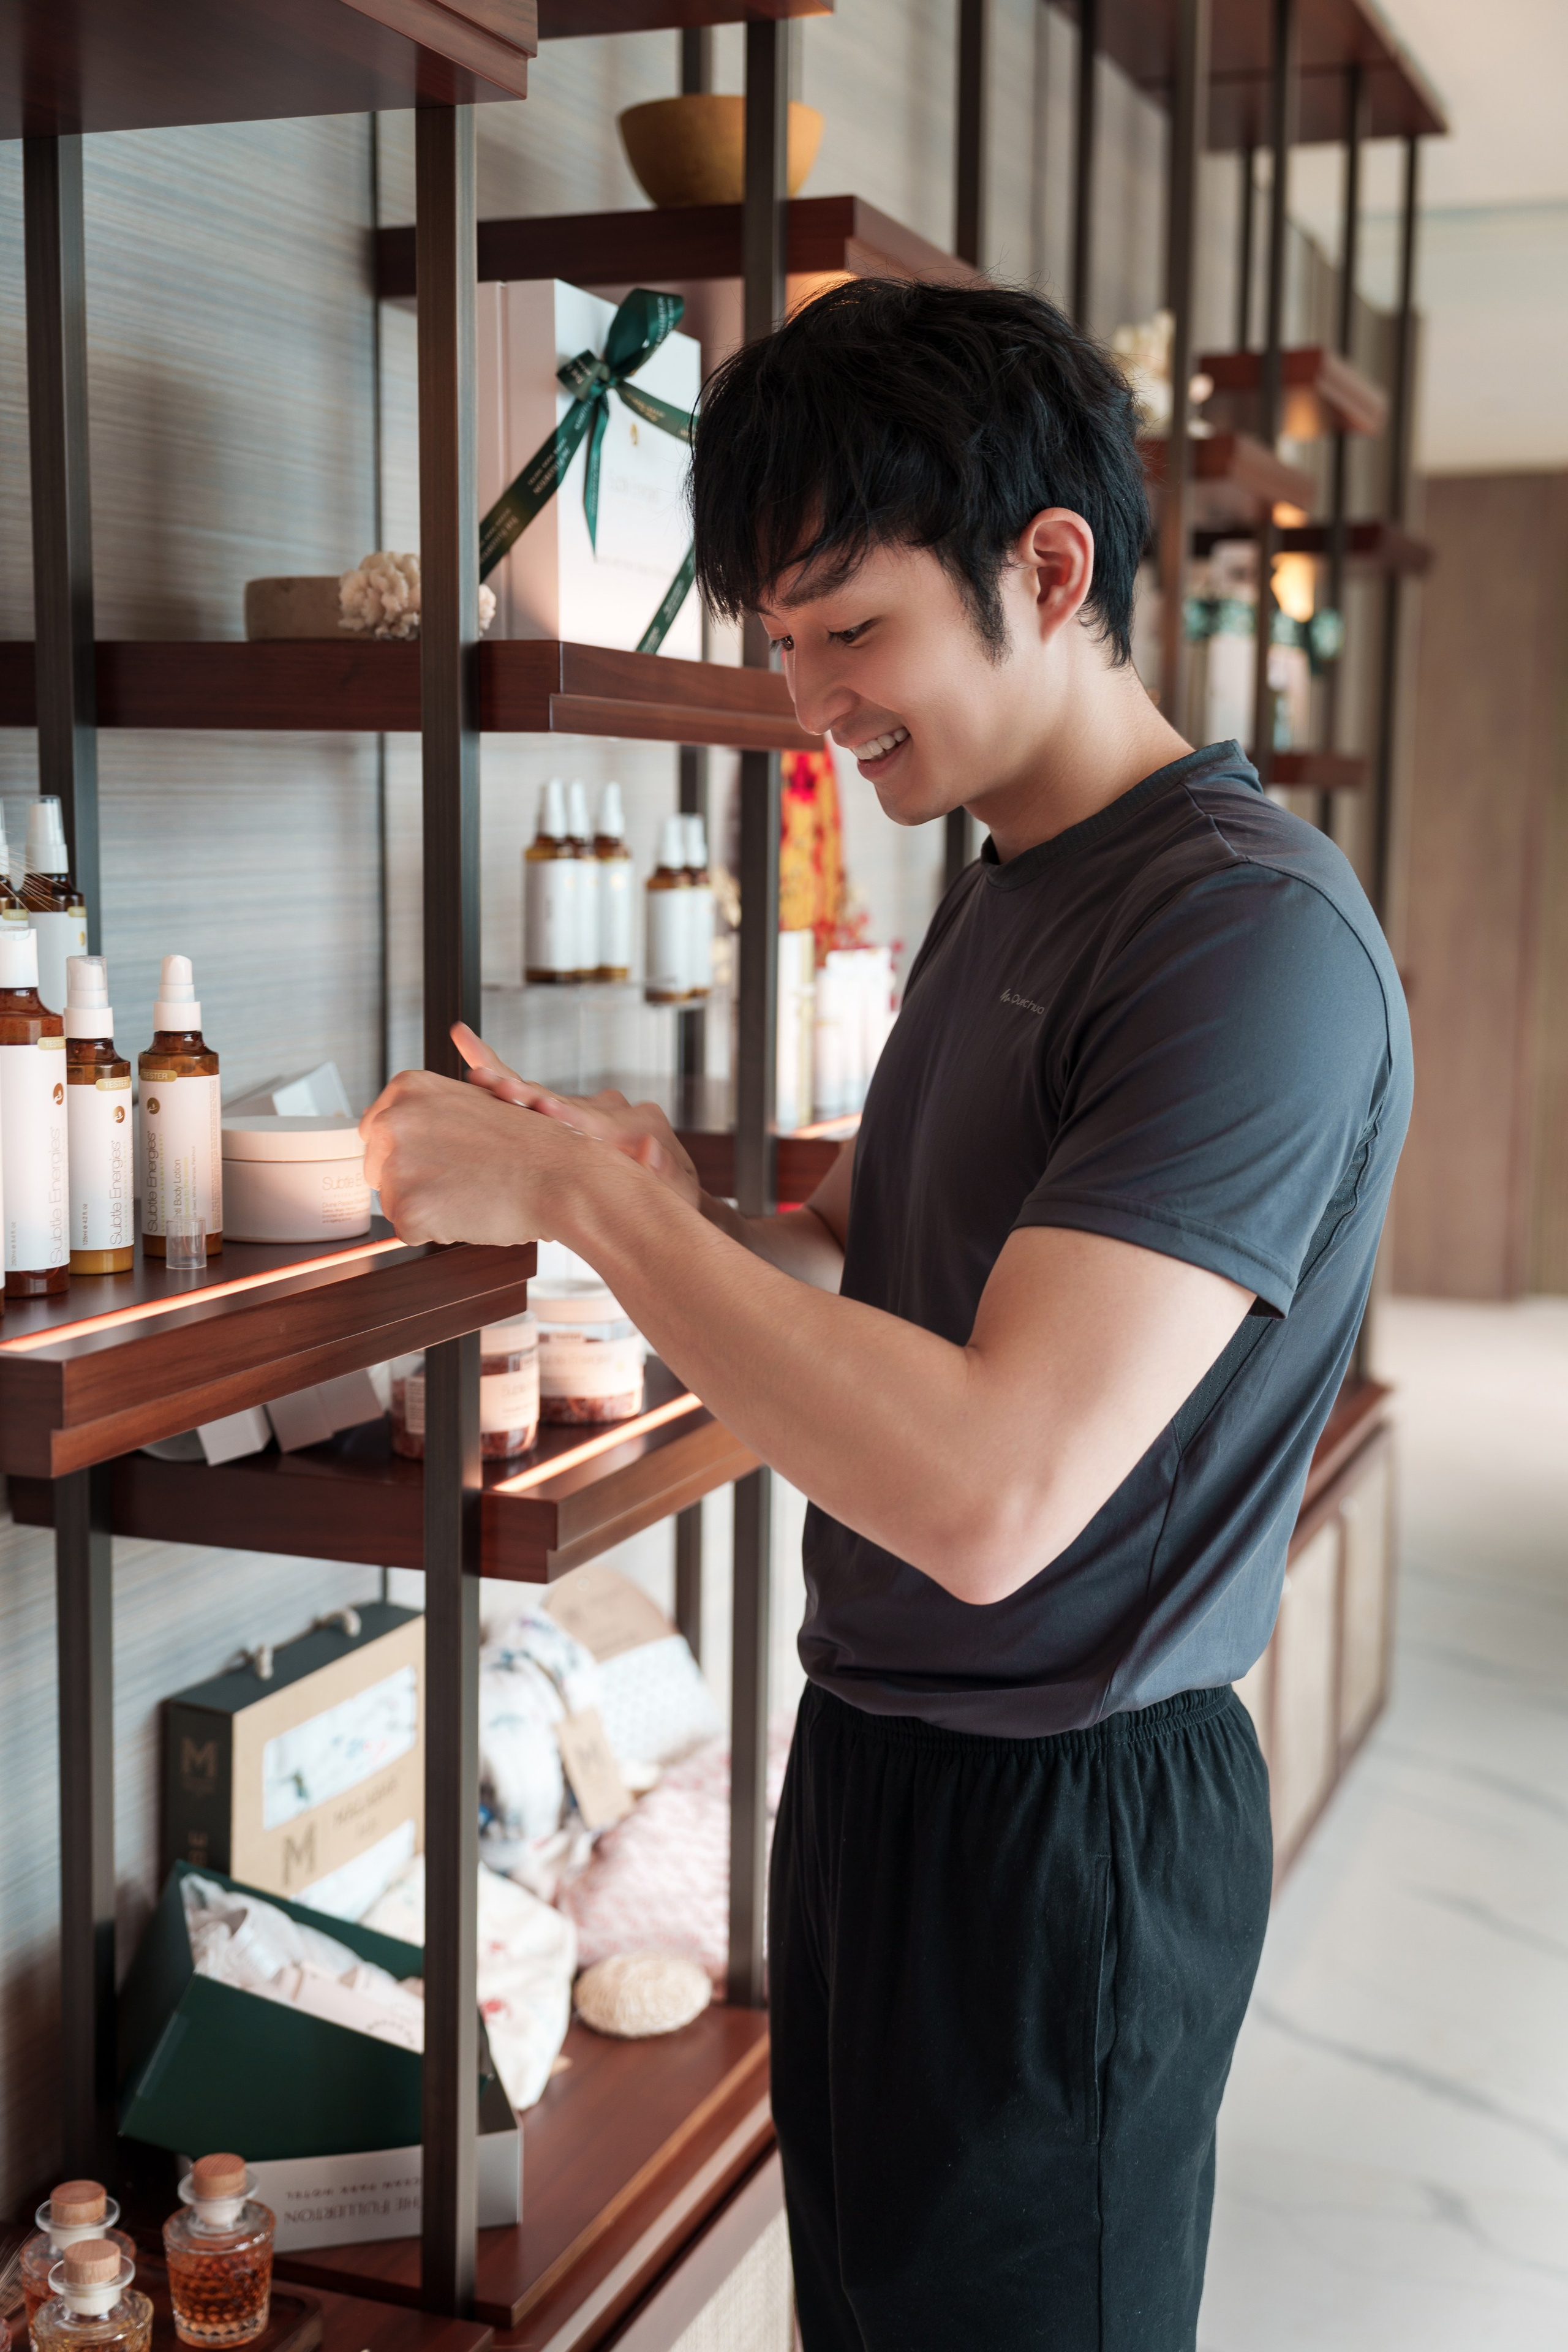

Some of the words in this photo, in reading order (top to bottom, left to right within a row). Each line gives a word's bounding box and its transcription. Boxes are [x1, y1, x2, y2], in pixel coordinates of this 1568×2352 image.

[1011, 993, 1045, 1015] Quechua
[143, 1071, 168, 1080] TESTER
[48, 1128, 62, 1204] Energies
[108, 1140, 124, 1199] Energies
[146, 1132, 159, 1188] Energies
[172, 1159, 183, 1184] Lotion
[147, 1191, 159, 1232] Subtle
[173, 1185, 184, 1207] Body
[48, 1208, 63, 1264] Subtle
[109, 1202, 123, 1245] Subtle
[181, 1735, 218, 1779] M
[281, 1819, 317, 1888] M
